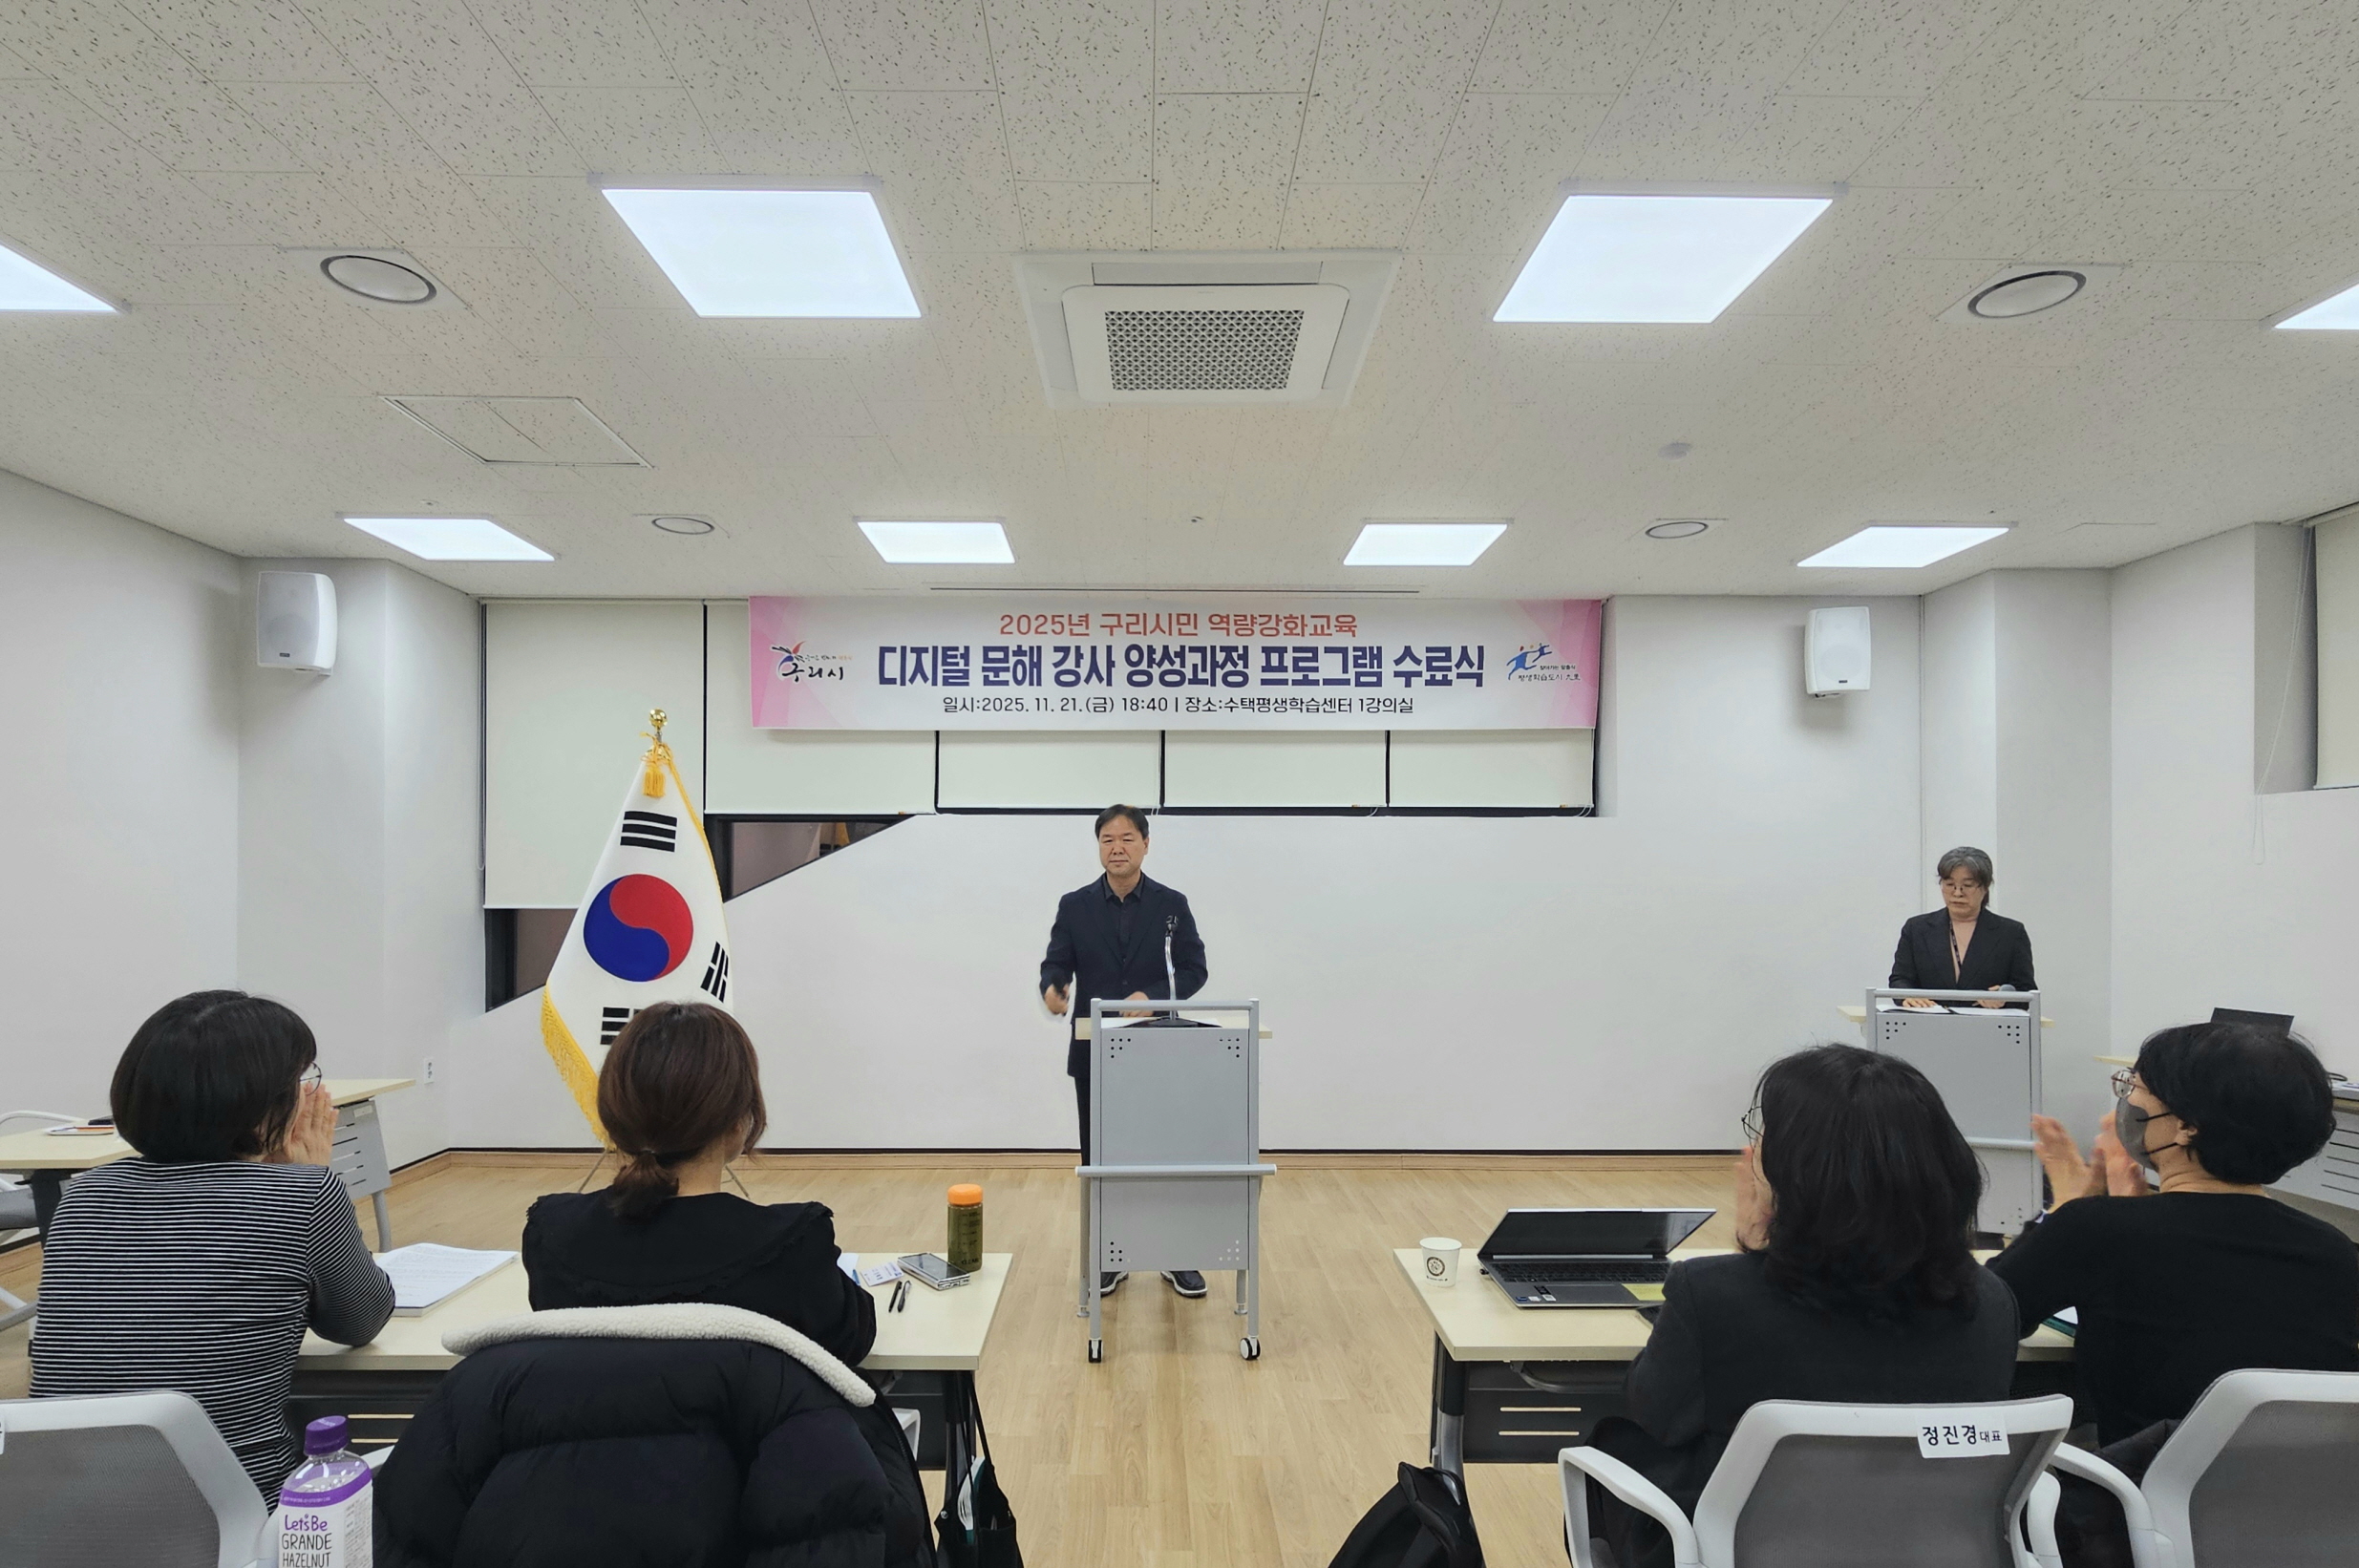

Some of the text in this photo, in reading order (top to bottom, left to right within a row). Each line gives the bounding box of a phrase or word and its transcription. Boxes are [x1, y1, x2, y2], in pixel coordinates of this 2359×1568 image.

[1000, 612, 1358, 638] 2025년 구리시민 역량강화교육
[878, 643, 1485, 689] 디지털 문해 강사 양성과정 프로그램 수료식
[1121, 696, 1168, 712] 18:40
[1184, 696, 1352, 714] 장소:수택평생학습센터
[1358, 697, 1414, 714] 1강의실
[281, 1533, 332, 1551] GRANDE
[282, 1552, 331, 1568] HAZELNUT
